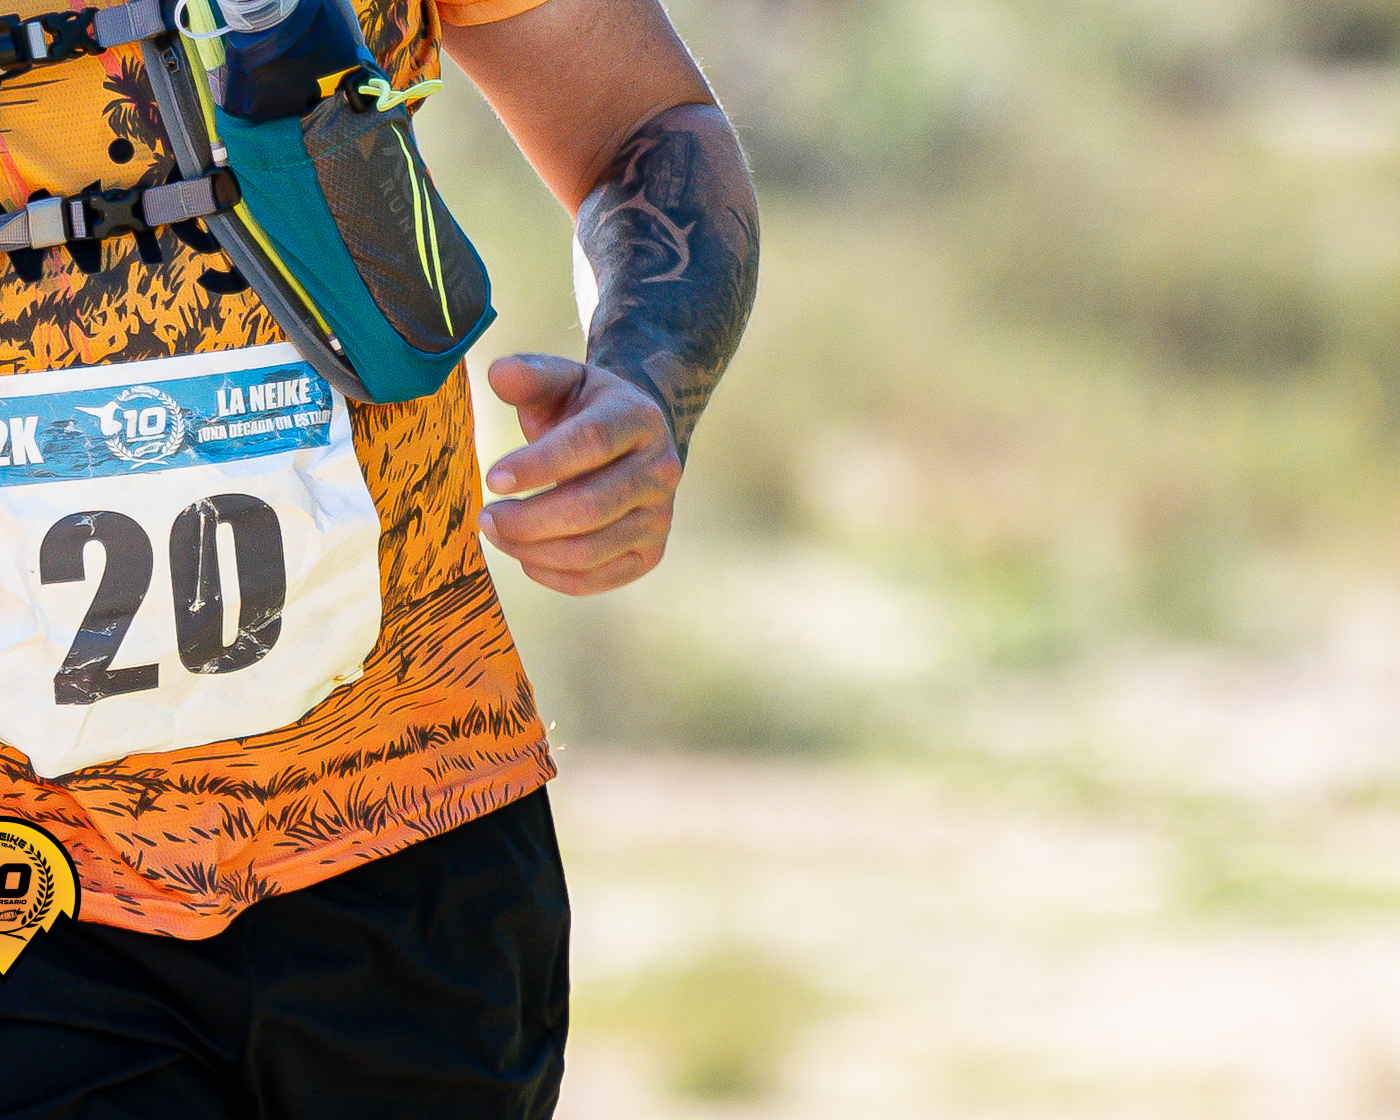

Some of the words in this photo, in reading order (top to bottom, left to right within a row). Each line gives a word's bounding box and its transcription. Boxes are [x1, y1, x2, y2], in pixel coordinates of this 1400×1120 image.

[217, 387, 246, 417] LA
[249, 377, 312, 412] NEIKE
[123, 406, 167, 438] 10
[275, 415, 293, 431] UN
[40, 493, 287, 705] 20
